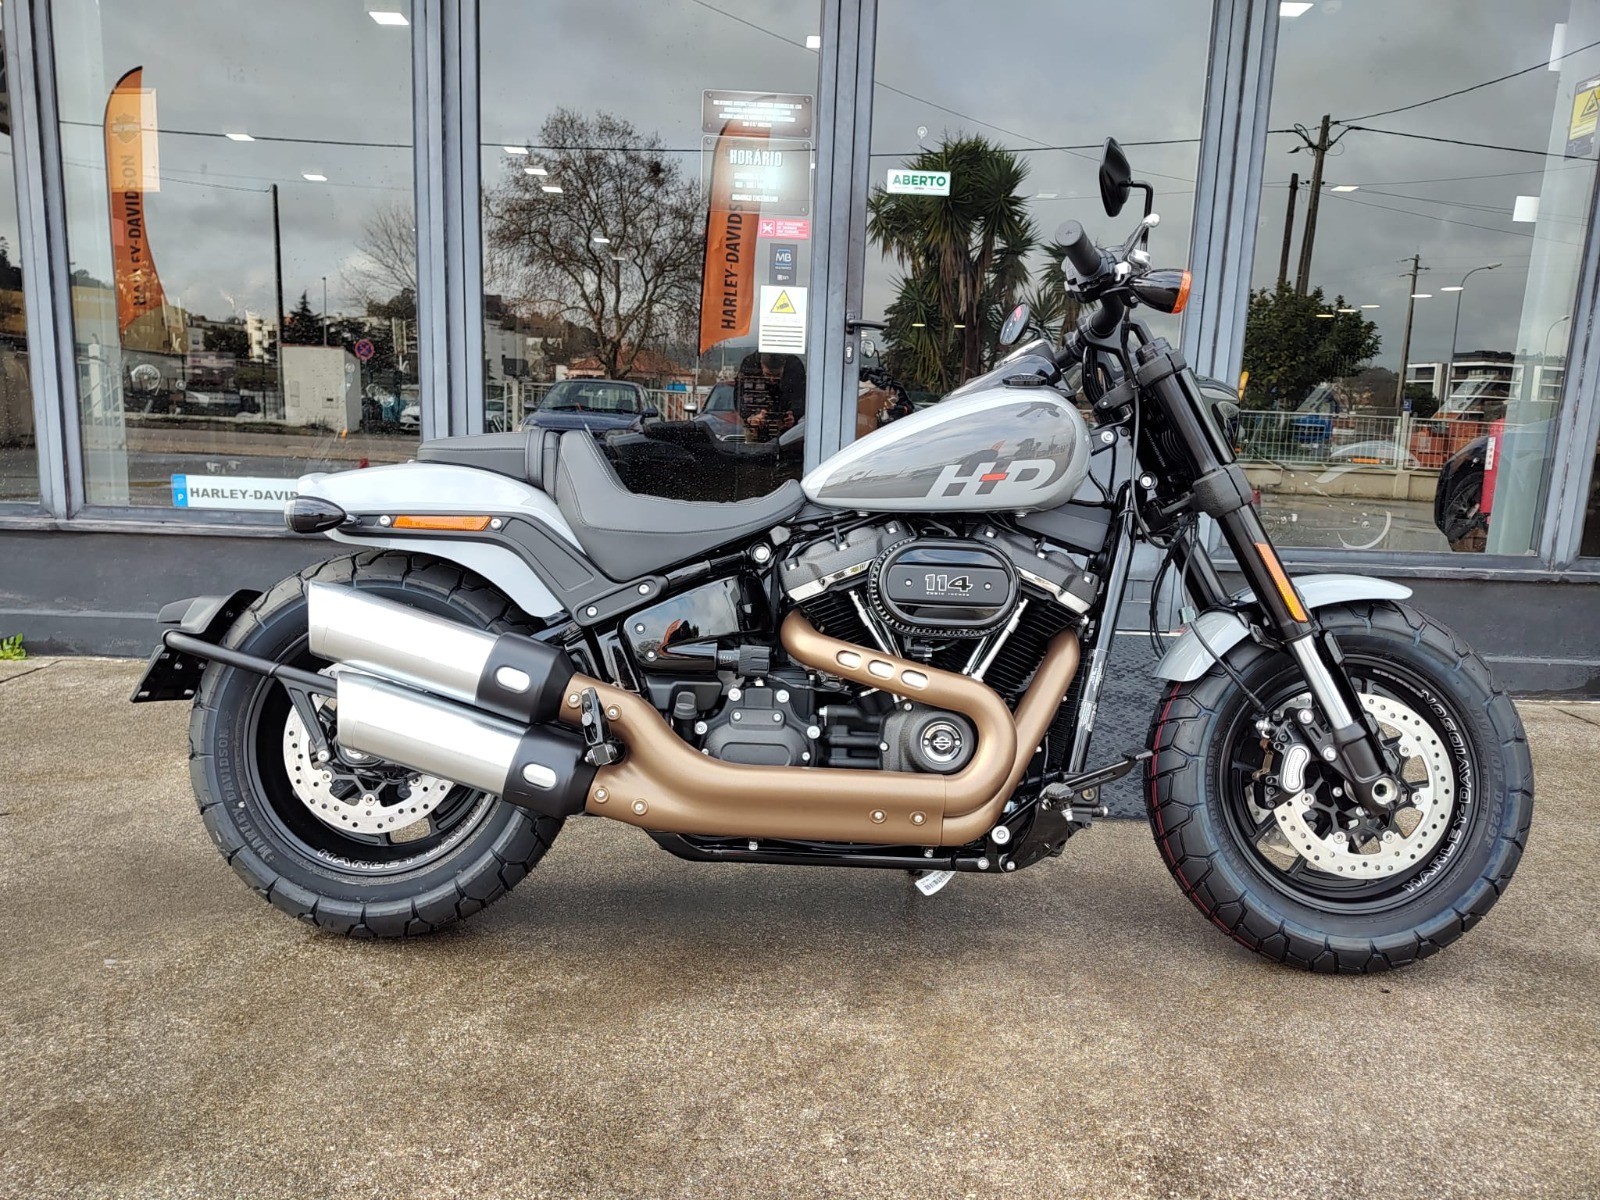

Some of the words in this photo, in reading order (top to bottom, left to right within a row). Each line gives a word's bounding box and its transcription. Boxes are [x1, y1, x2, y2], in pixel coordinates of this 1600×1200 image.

[729, 149, 783, 167] HORÁRIO
[892, 174, 947, 187] ABERTO
[775, 252, 792, 262] MB
[720, 203, 743, 330] HARLEY-DAVIDS
[925, 574, 974, 593] 114
